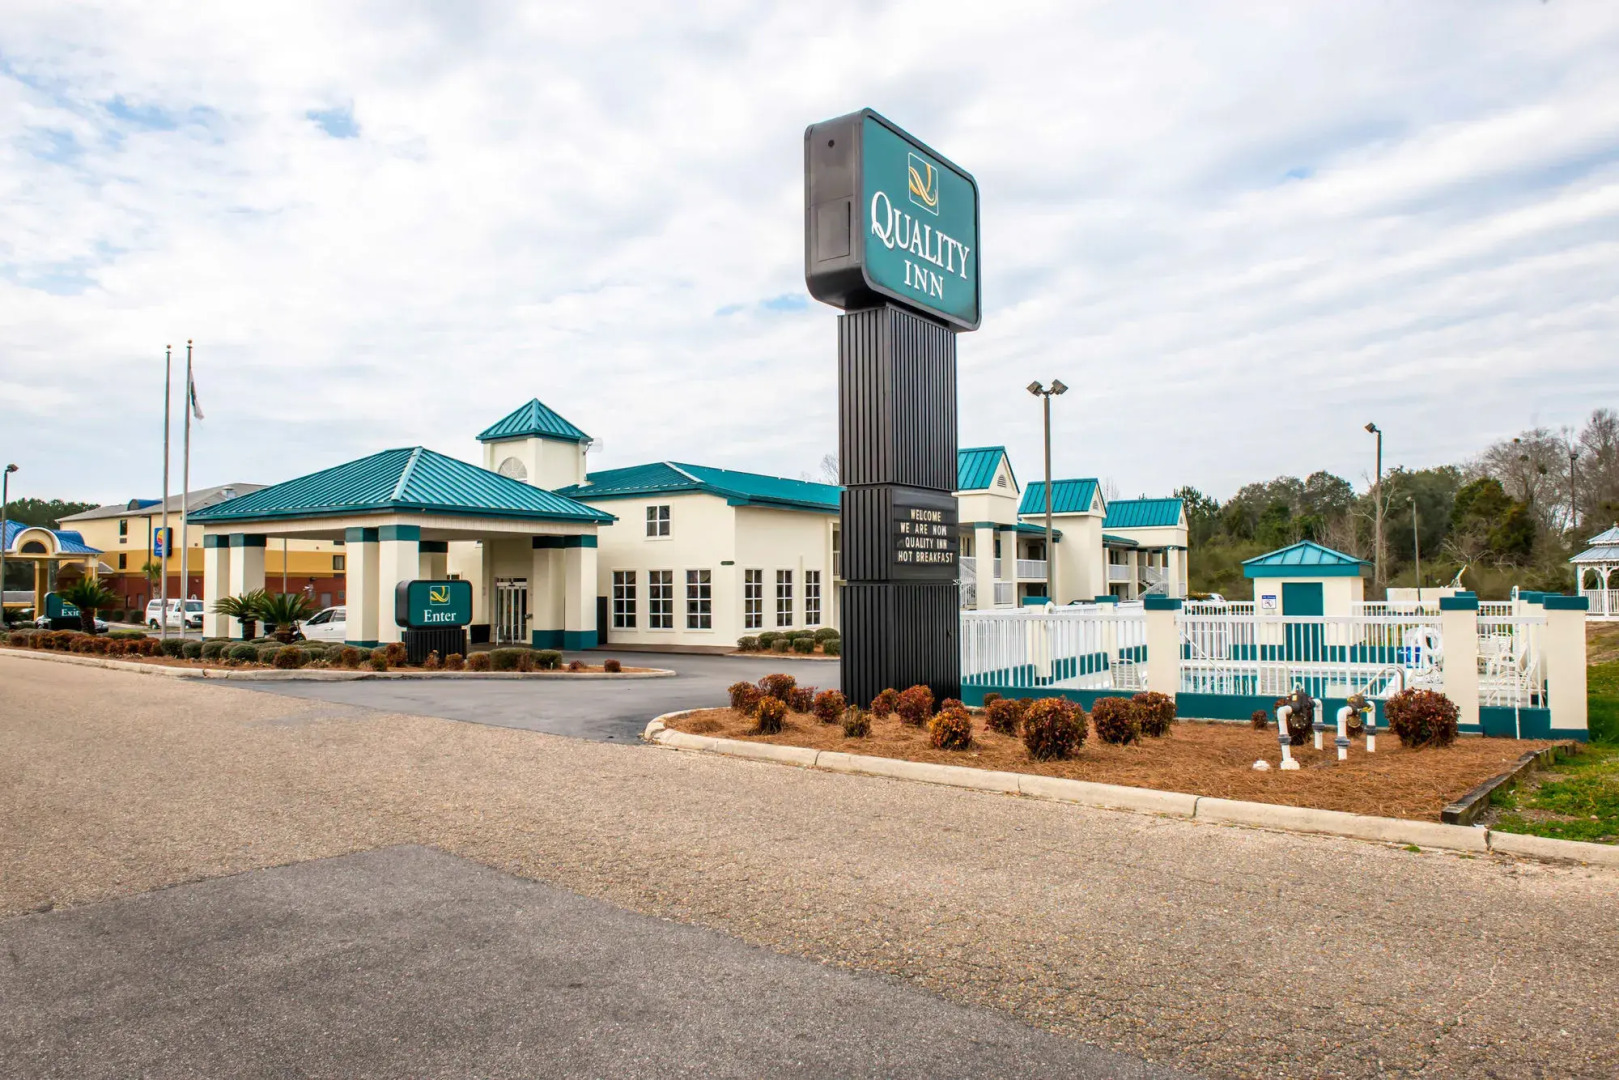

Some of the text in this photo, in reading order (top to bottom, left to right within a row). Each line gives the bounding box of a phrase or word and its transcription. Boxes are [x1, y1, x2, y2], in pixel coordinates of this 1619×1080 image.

[871, 191, 970, 279] QUALITY
[904, 260, 944, 300] INN
[910, 508, 942, 522] WELCOME
[900, 522, 910, 534] WE
[915, 523, 928, 535] ARE
[905, 537, 948, 549] QUALITY INN
[898, 550, 954, 563] HOT BREAKFAST
[61, 608, 80, 617] Exit
[424, 609, 457, 623] Enter
